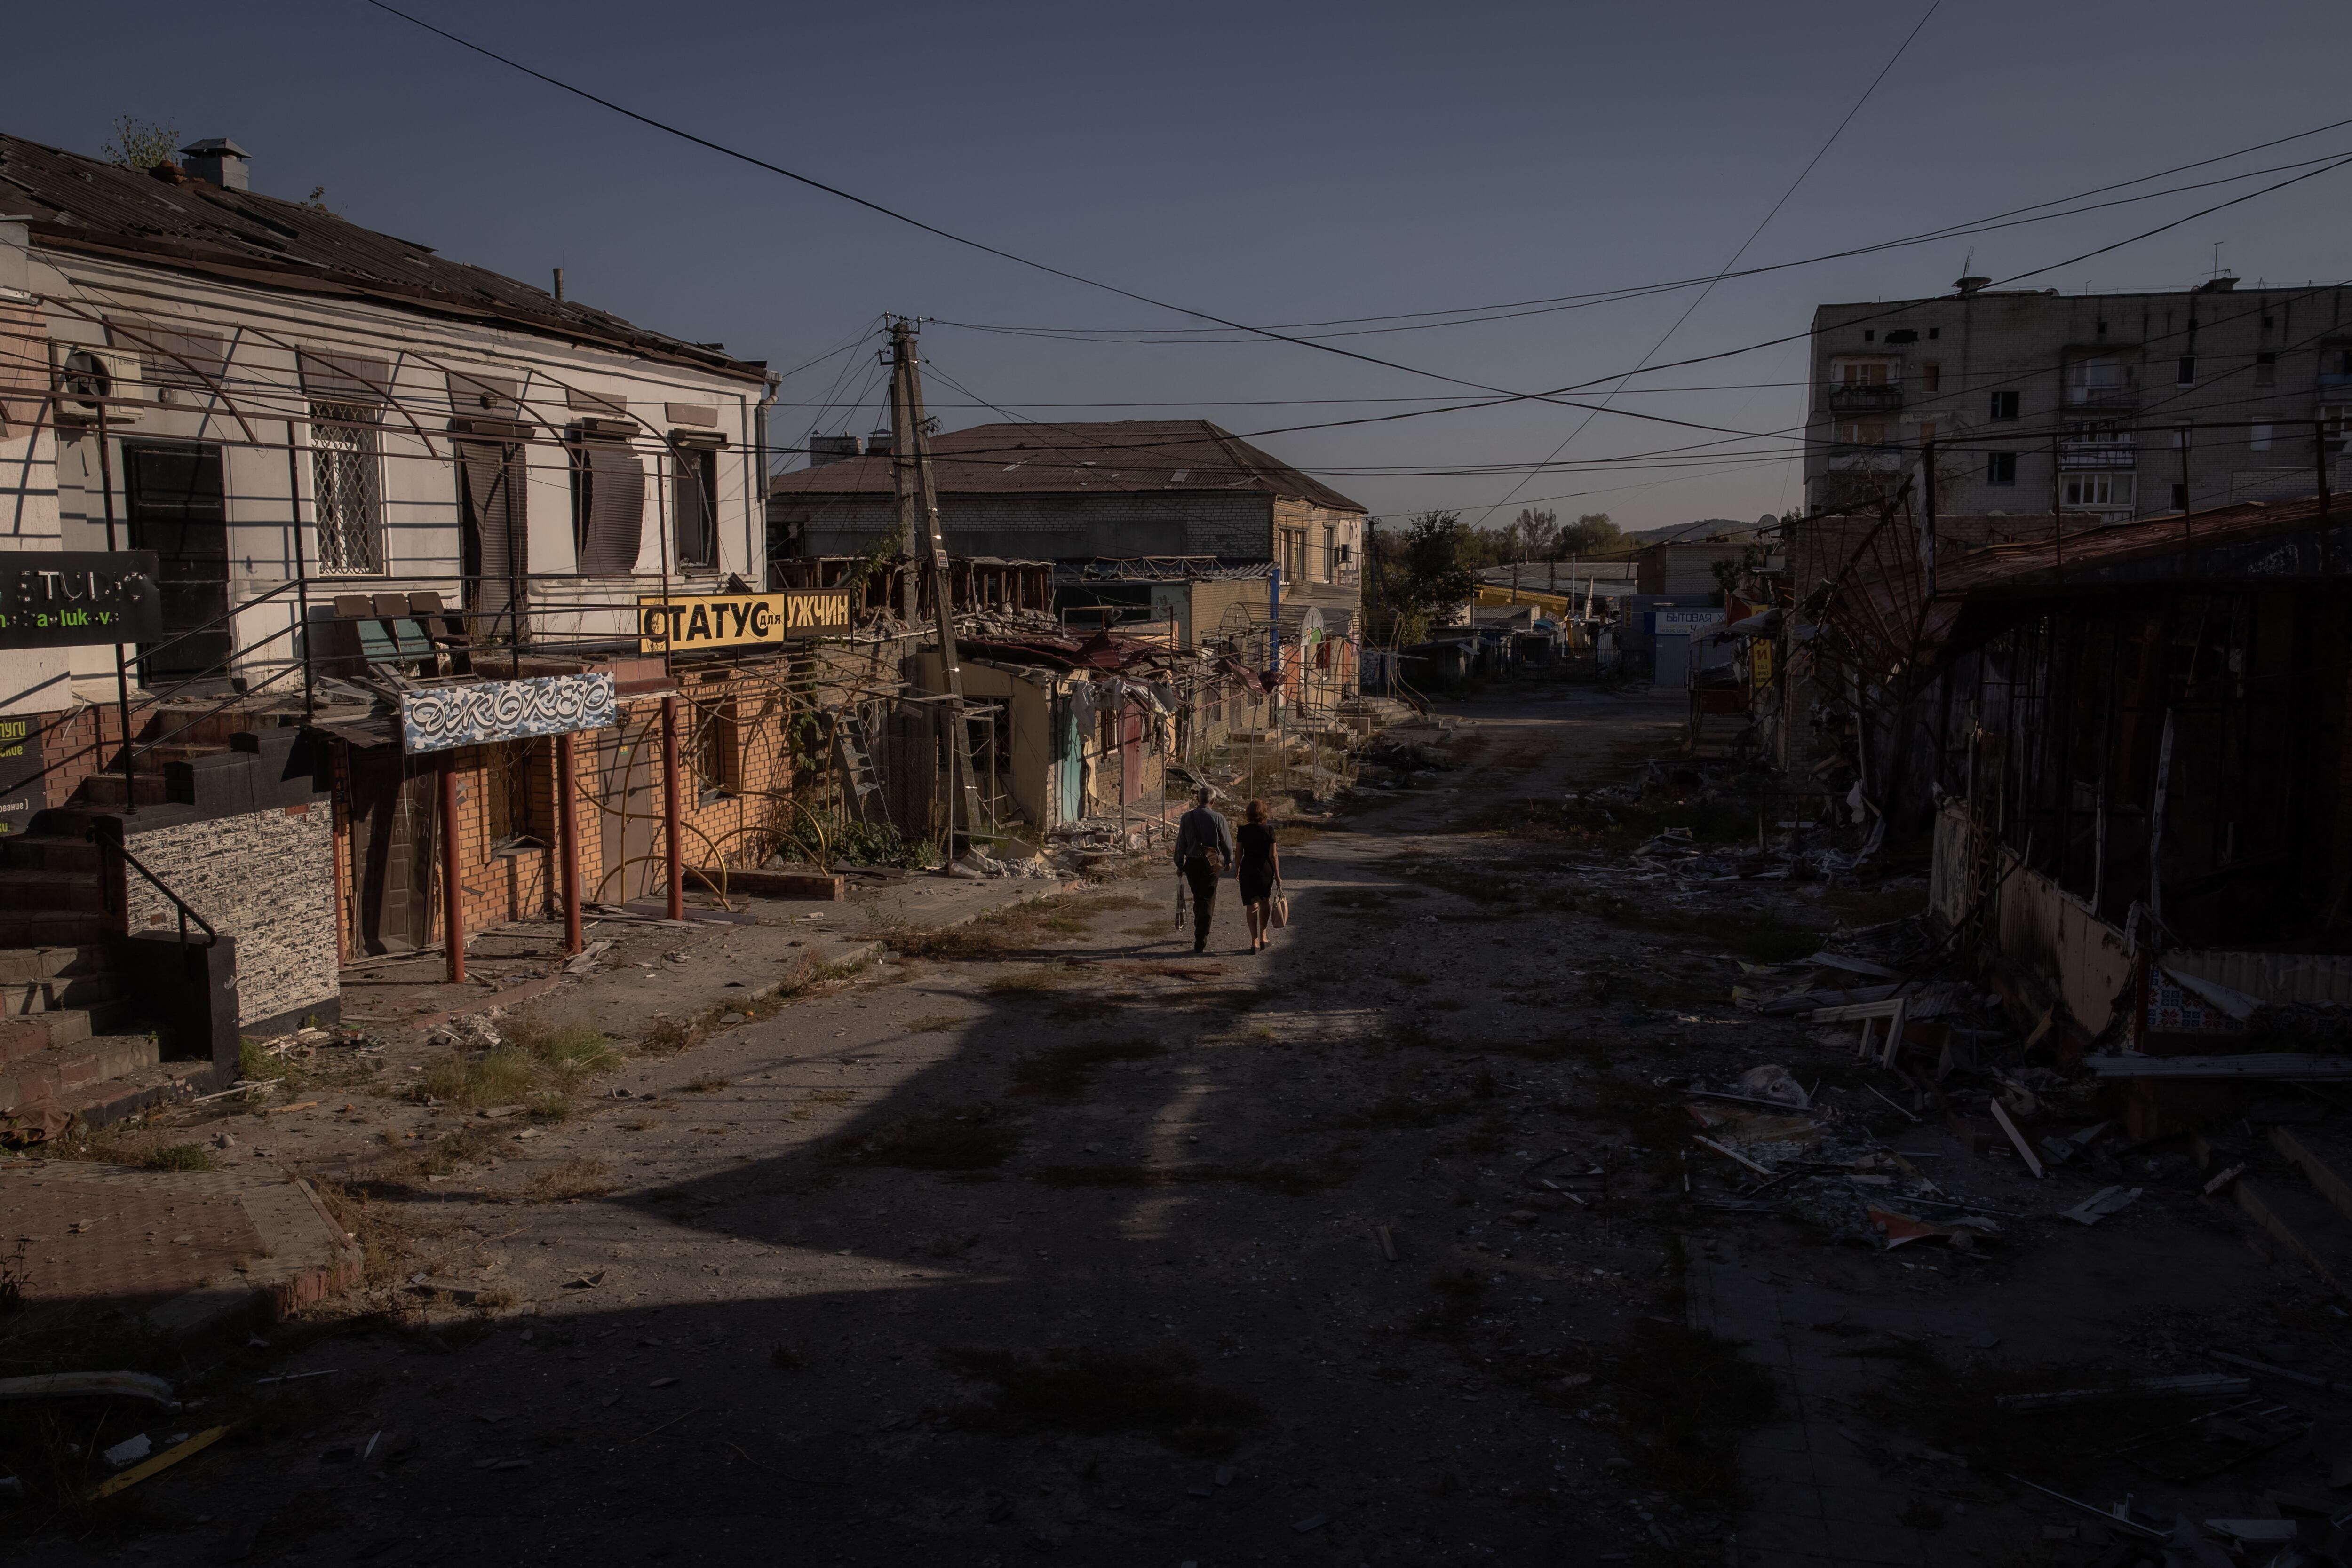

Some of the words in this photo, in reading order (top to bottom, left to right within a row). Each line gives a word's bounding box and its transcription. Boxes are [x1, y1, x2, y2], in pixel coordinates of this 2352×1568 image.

[644, 602, 770, 642] СТАТУС
[787, 595, 849, 627] УЖЧИН
[1666, 613, 1712, 622] БЫТОВАЯ
